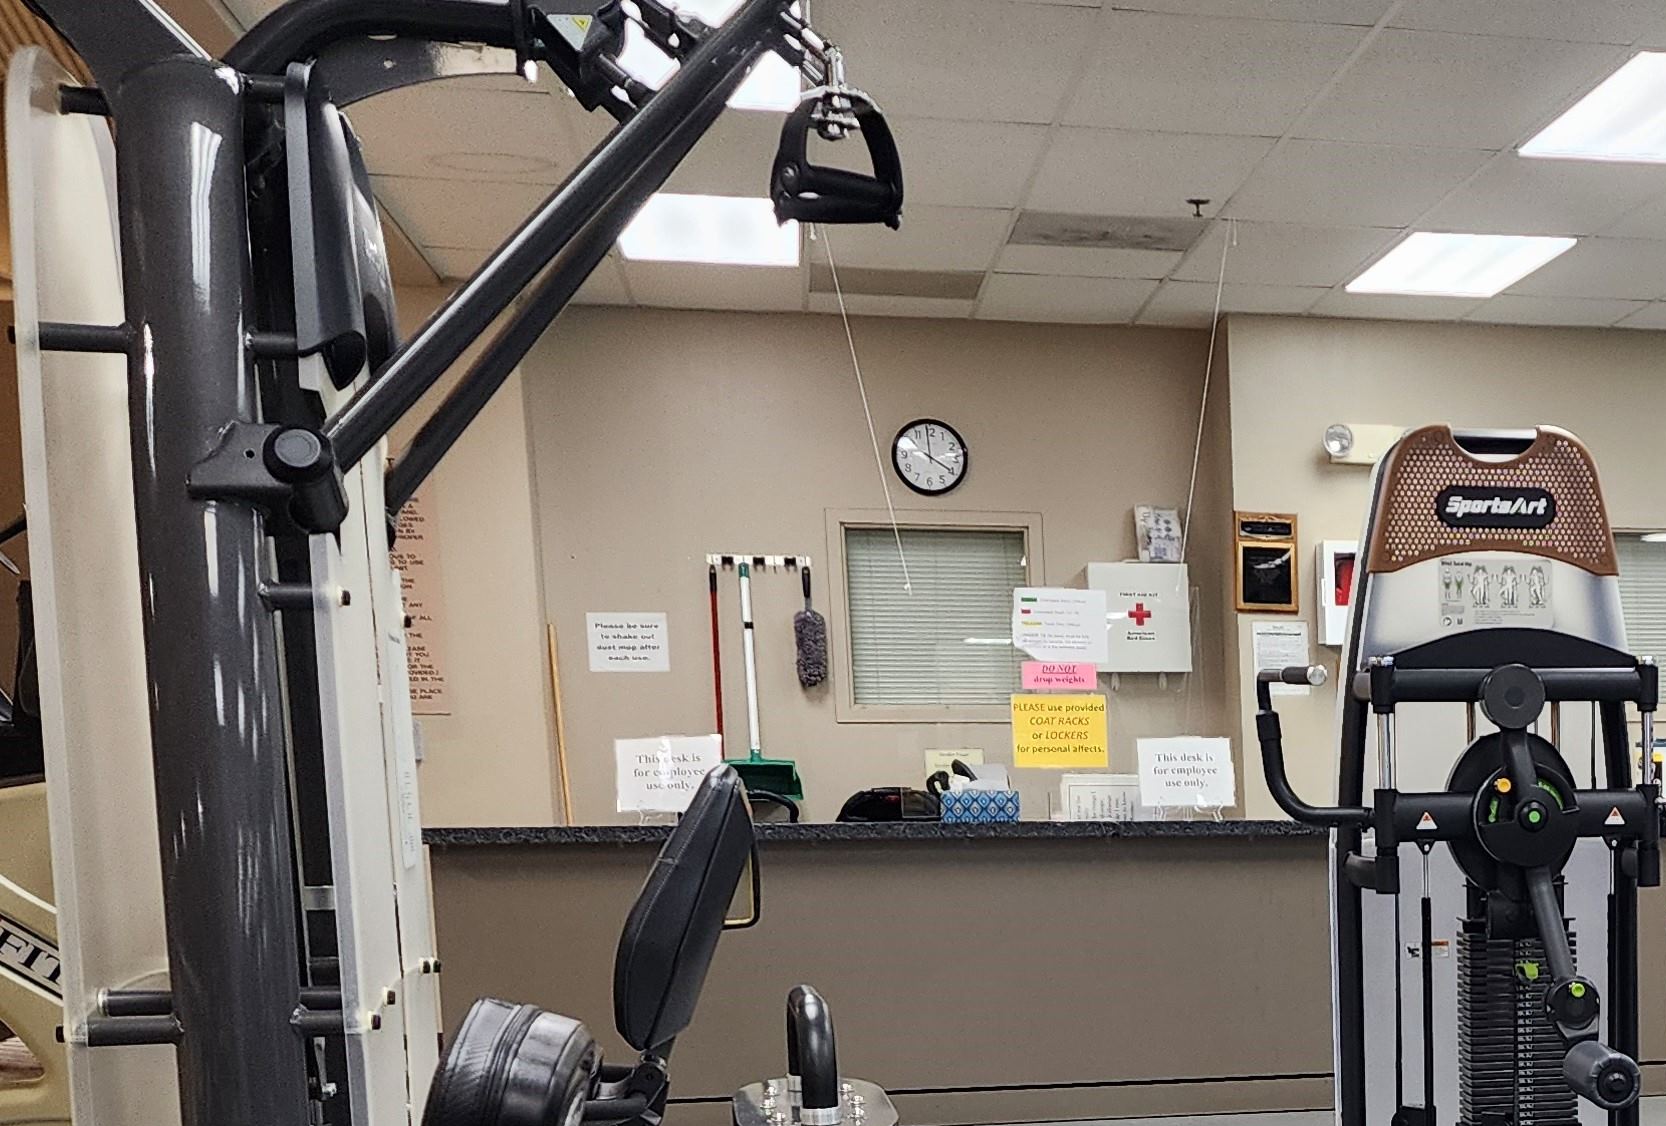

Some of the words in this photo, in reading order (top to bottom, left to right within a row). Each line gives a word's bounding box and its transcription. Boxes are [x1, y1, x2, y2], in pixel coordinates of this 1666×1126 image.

[901, 450, 908, 459] 9
[926, 477, 933, 487] 6
[1042, 664, 1056, 674] DO
[1058, 664, 1077, 674] NOT
[1033, 676, 1053, 685] drop
[1055, 676, 1085, 684] weights
[1013, 703, 1045, 712] PLEASE
[1065, 703, 1105, 713] provided
[1029, 716, 1056, 726] COAT
[1058, 716, 1090, 726] RACKS
[1032, 732, 1043, 740] or
[1045, 731, 1089, 740] LOCKERS
[1017, 744, 1030, 753] for
[1032, 744, 1071, 755] personal
[635, 754, 660, 764] This
[663, 753, 689, 763] esk
[691, 753, 702, 761] is
[1155, 753, 1178, 762] This
[1180, 753, 1202, 762] desk
[1205, 753, 1214, 762] is
[633, 768, 650, 777] for
[653, 767, 705, 779] eployee
[1153, 766, 1169, 775] for
[1171, 766, 1218, 778] employee
[667, 781, 694, 792] only.
[1165, 779, 1182, 787] use
[1183, 779, 1208, 789] only.
